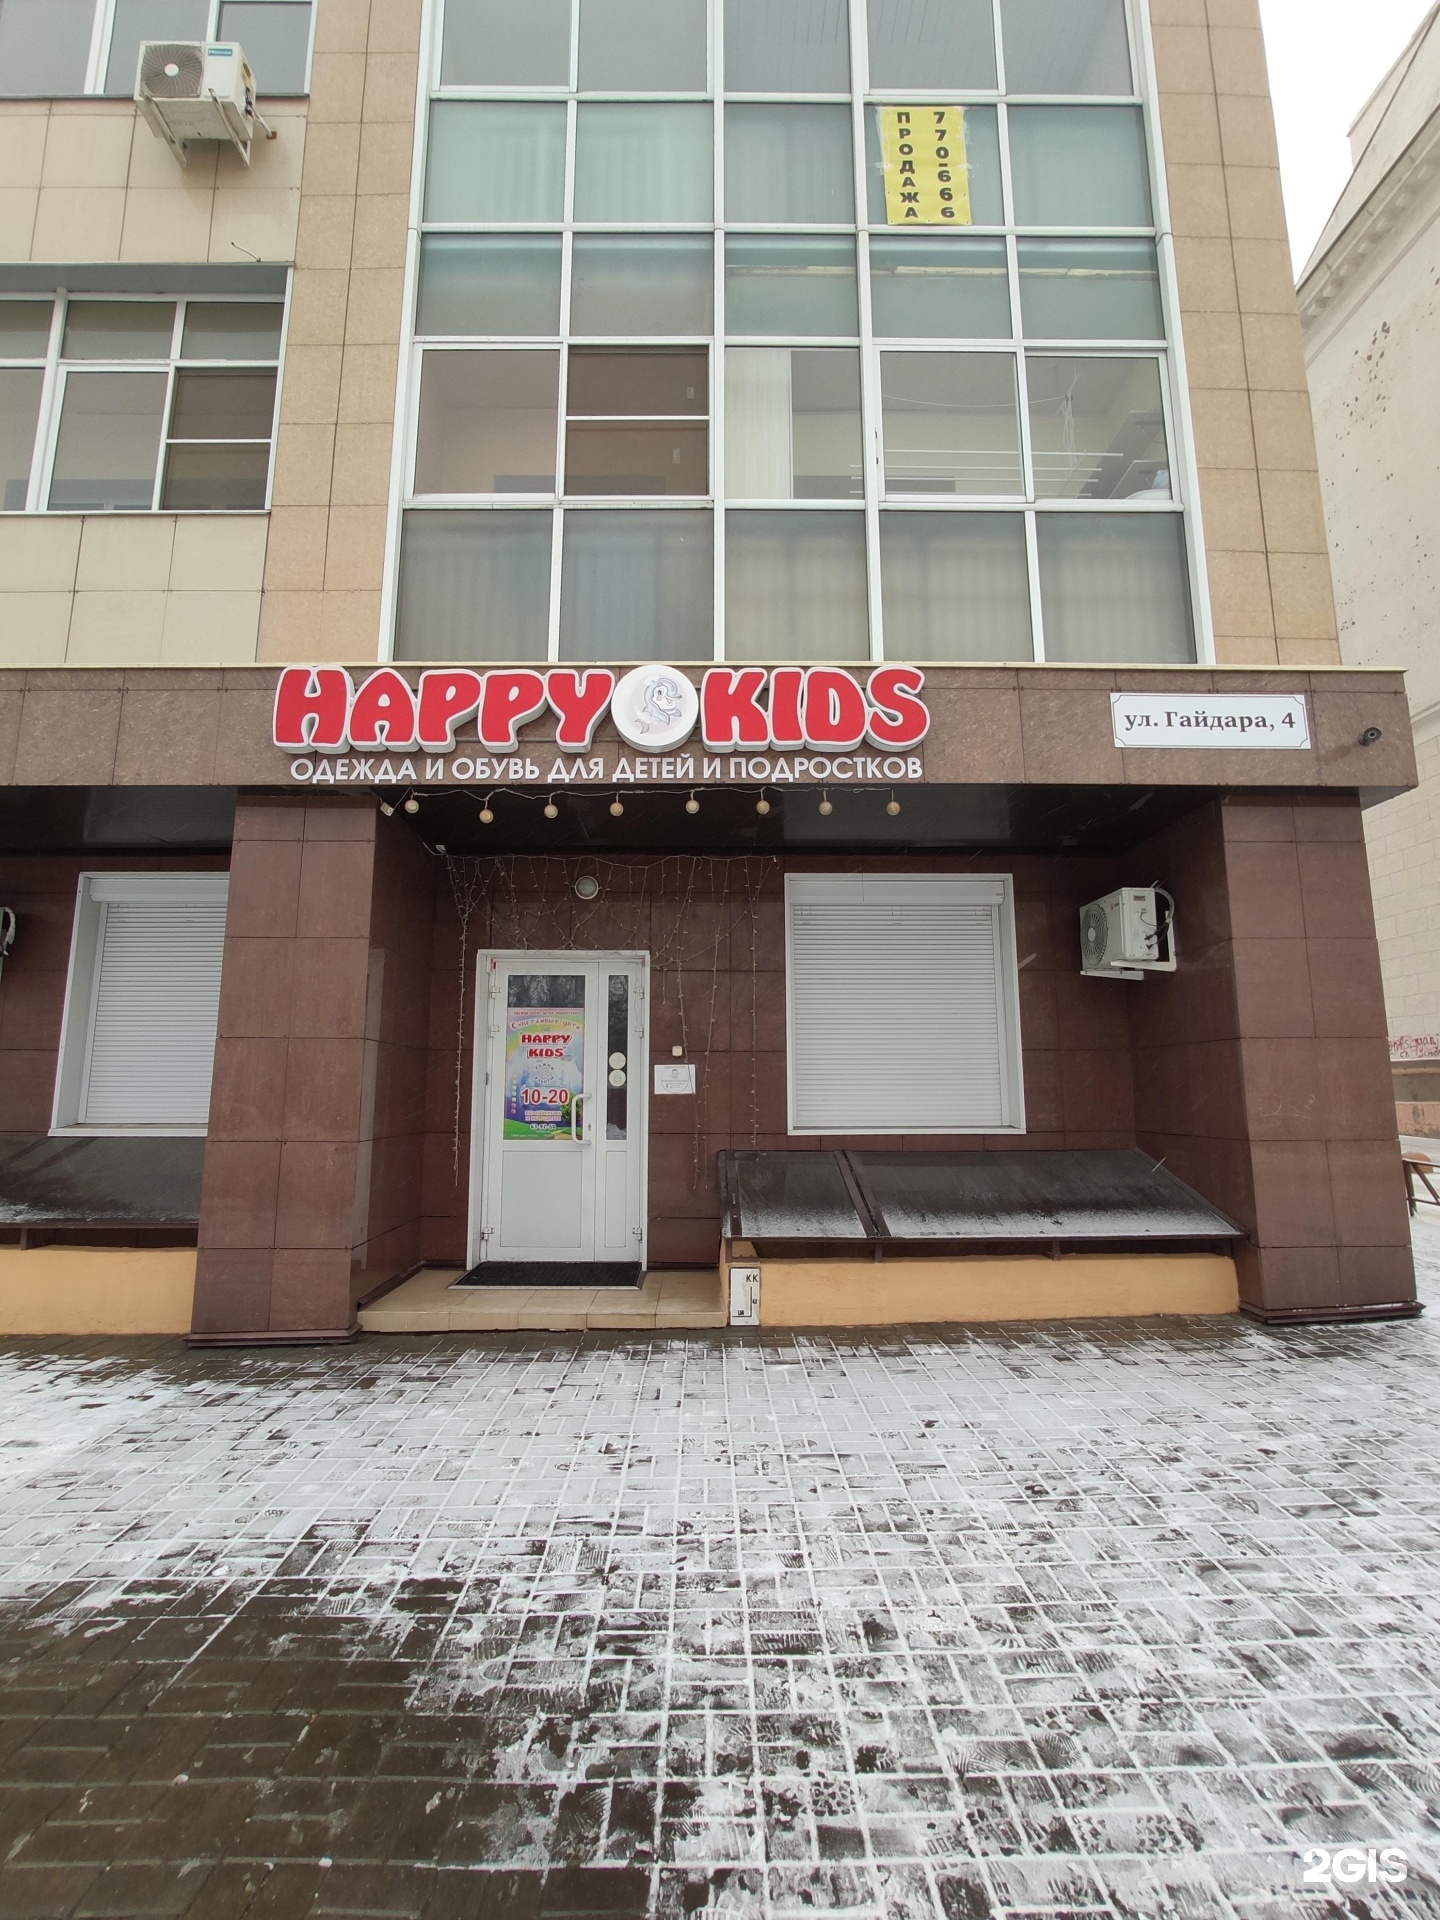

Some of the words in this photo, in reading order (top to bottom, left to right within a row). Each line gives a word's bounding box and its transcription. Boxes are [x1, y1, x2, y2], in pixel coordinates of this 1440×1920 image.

[897, 111, 920, 218] ПРОДАЖА
[933, 111, 956, 219] 770-666
[273, 665, 616, 753] HAPPY
[701, 665, 931, 753] KIDS
[1123, 712, 1159, 731] ул.
[1164, 710, 1276, 732] Гайдара,
[1281, 711, 1297, 729] 4
[290, 757, 417, 784] ОДЕЖДА
[424, 758, 445, 780] И
[451, 757, 540, 781] ОБУВЬ
[547, 758, 605, 784] ДЛЯ
[612, 752, 695, 783] ДЕТЕЙ
[703, 758, 722, 780] И
[729, 756, 923, 784] ПОДРОСТКОВ
[521, 1088, 569, 1105] 10-20
